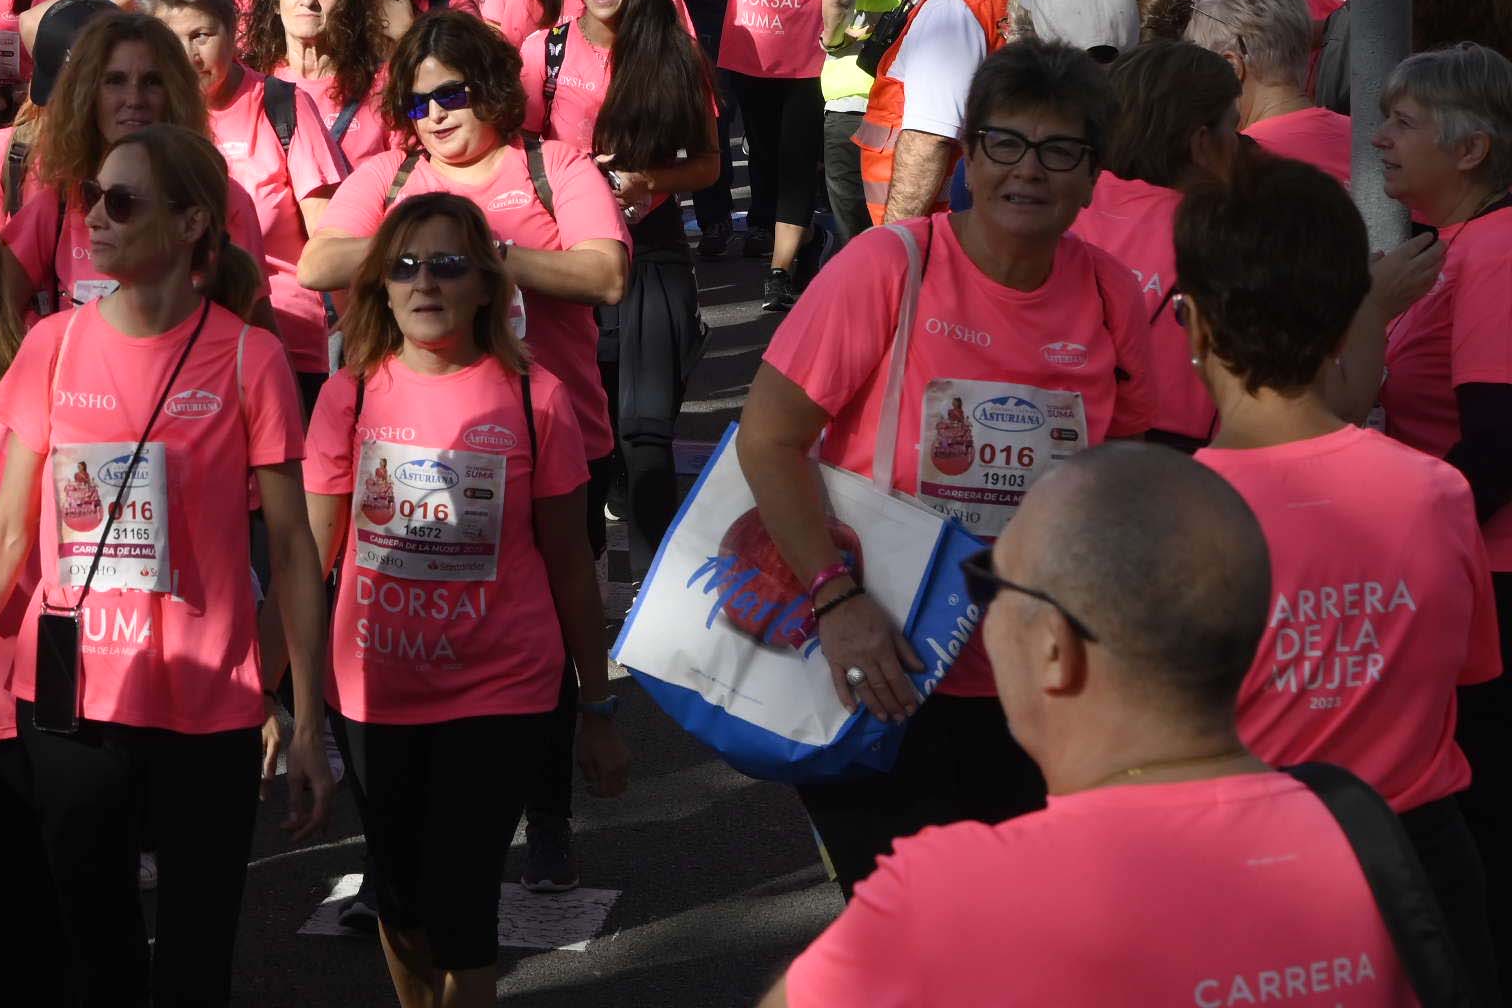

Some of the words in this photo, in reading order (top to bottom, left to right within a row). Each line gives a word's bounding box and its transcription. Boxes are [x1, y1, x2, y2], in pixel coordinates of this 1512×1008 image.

[926, 317, 991, 348] OYSHO
[979, 407, 1040, 425] ASTURIANA
[359, 426, 416, 441] OYSHO
[979, 443, 1034, 468] 016
[399, 469, 454, 485] ASTURIANA
[465, 470, 494, 480] SUMA
[983, 472, 1025, 487] 19103
[107, 500, 154, 521] 016
[400, 500, 449, 523] 016
[113, 528, 150, 540] 31165
[404, 524, 442, 539] 14572
[116, 546, 129, 555] DE
[130, 547, 141, 556] LA
[1271, 580, 1417, 629] ARRERA
[81, 607, 153, 643] UMA
[355, 618, 457, 661] SUMA
[1275, 625, 1322, 660] DE
[1334, 616, 1379, 651] LA
[1271, 655, 1386, 692] MUJER
[1309, 696, 1343, 709] 2023
[1192, 952, 1376, 1008] CARRERA
